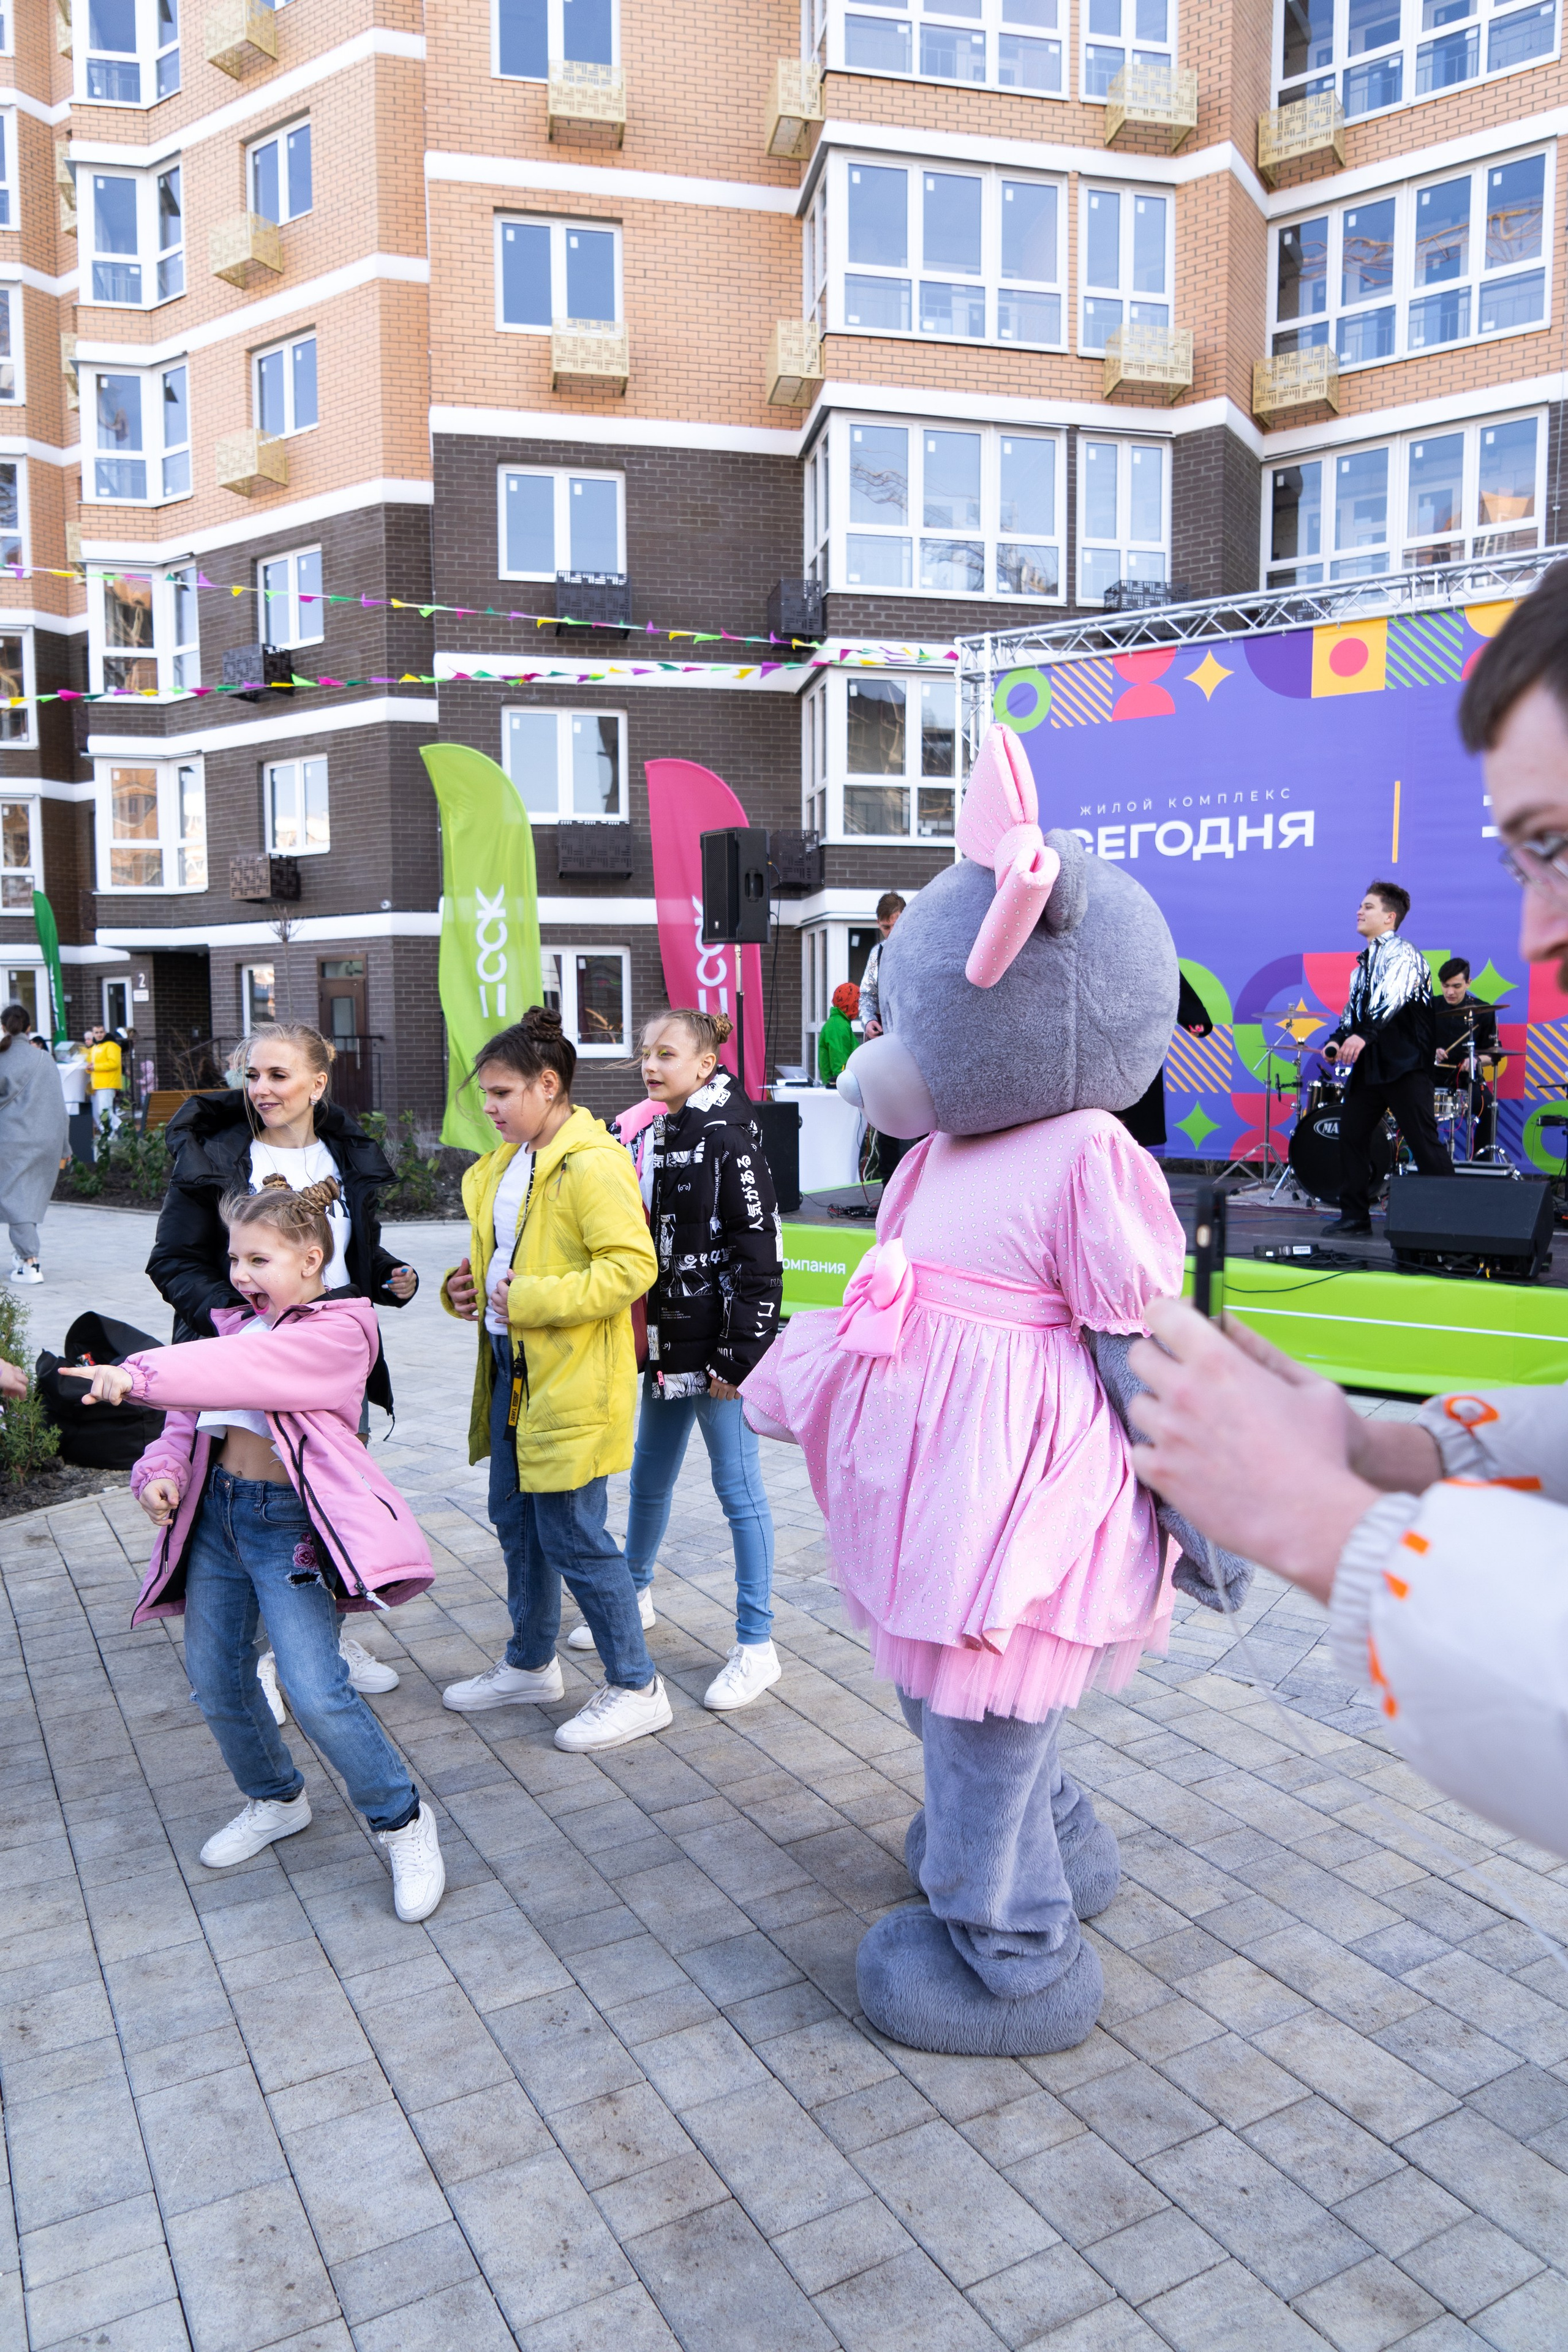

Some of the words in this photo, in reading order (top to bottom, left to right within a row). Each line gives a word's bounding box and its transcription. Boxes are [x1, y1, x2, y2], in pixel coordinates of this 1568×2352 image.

[1080, 798, 1153, 816] ЖИЛОЙ
[1168, 788, 1291, 809] КОМПЛЕКС
[138, 973, 146, 988] 2
[736, 1155, 764, 1231] 人気がある
[782, 1258, 846, 1275] омпания
